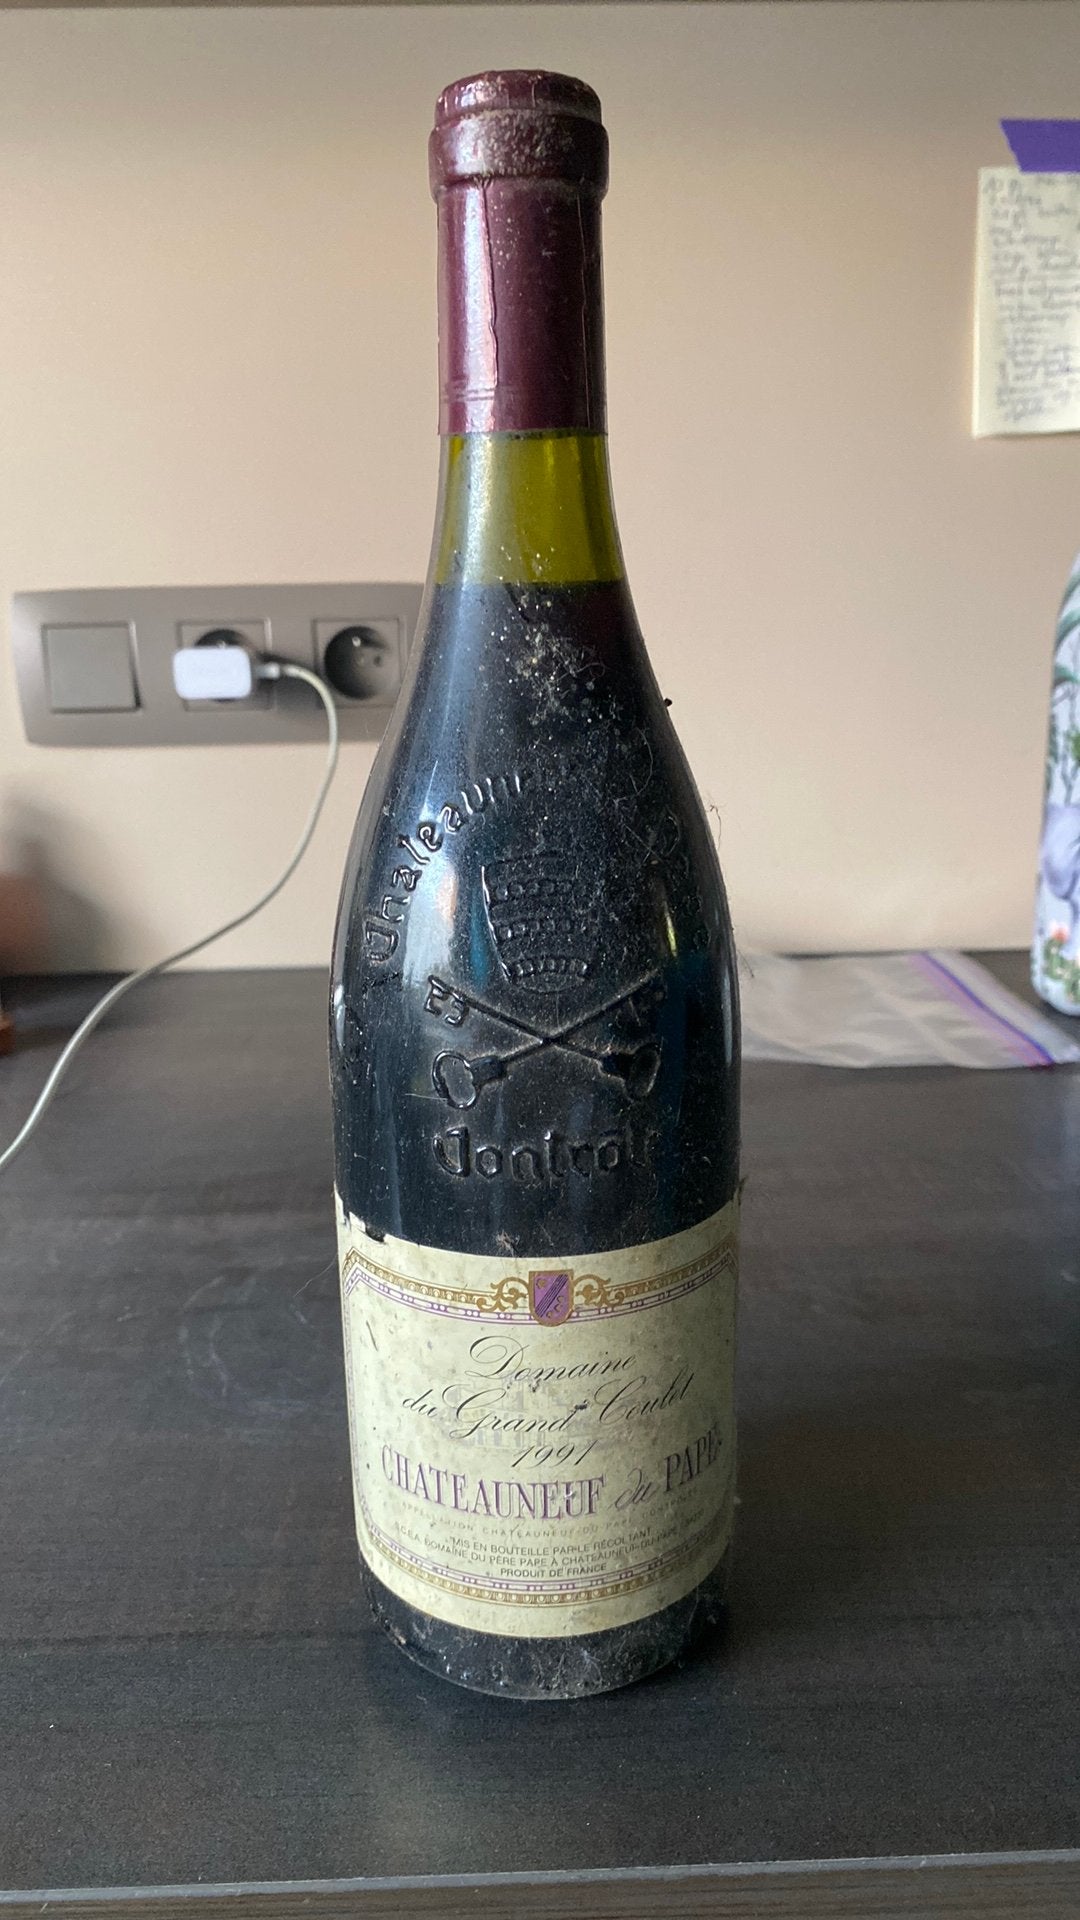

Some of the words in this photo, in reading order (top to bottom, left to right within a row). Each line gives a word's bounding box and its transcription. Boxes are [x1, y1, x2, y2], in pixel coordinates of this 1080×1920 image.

[465, 1335, 637, 1381] Domaine
[402, 1388, 440, 1419] du
[441, 1384, 587, 1439] Grand
[594, 1365, 695, 1424] Coulet
[511, 1439, 599, 1468] 1991
[381, 1443, 606, 1521] CHATEAUNEUF
[608, 1467, 661, 1511] du
[663, 1422, 721, 1493] PAPE
[424, 1537, 470, 1560] DOMAINE
[471, 1552, 486, 1563] DU
[519, 1555, 548, 1566] PAPE
[473, 1541, 487, 1552] EN
[490, 1543, 551, 1557] BOUTEILLE
[500, 1567, 546, 1578] PRODUIT
[549, 1567, 564, 1578] DE
[566, 1564, 607, 1577] FRANCE
